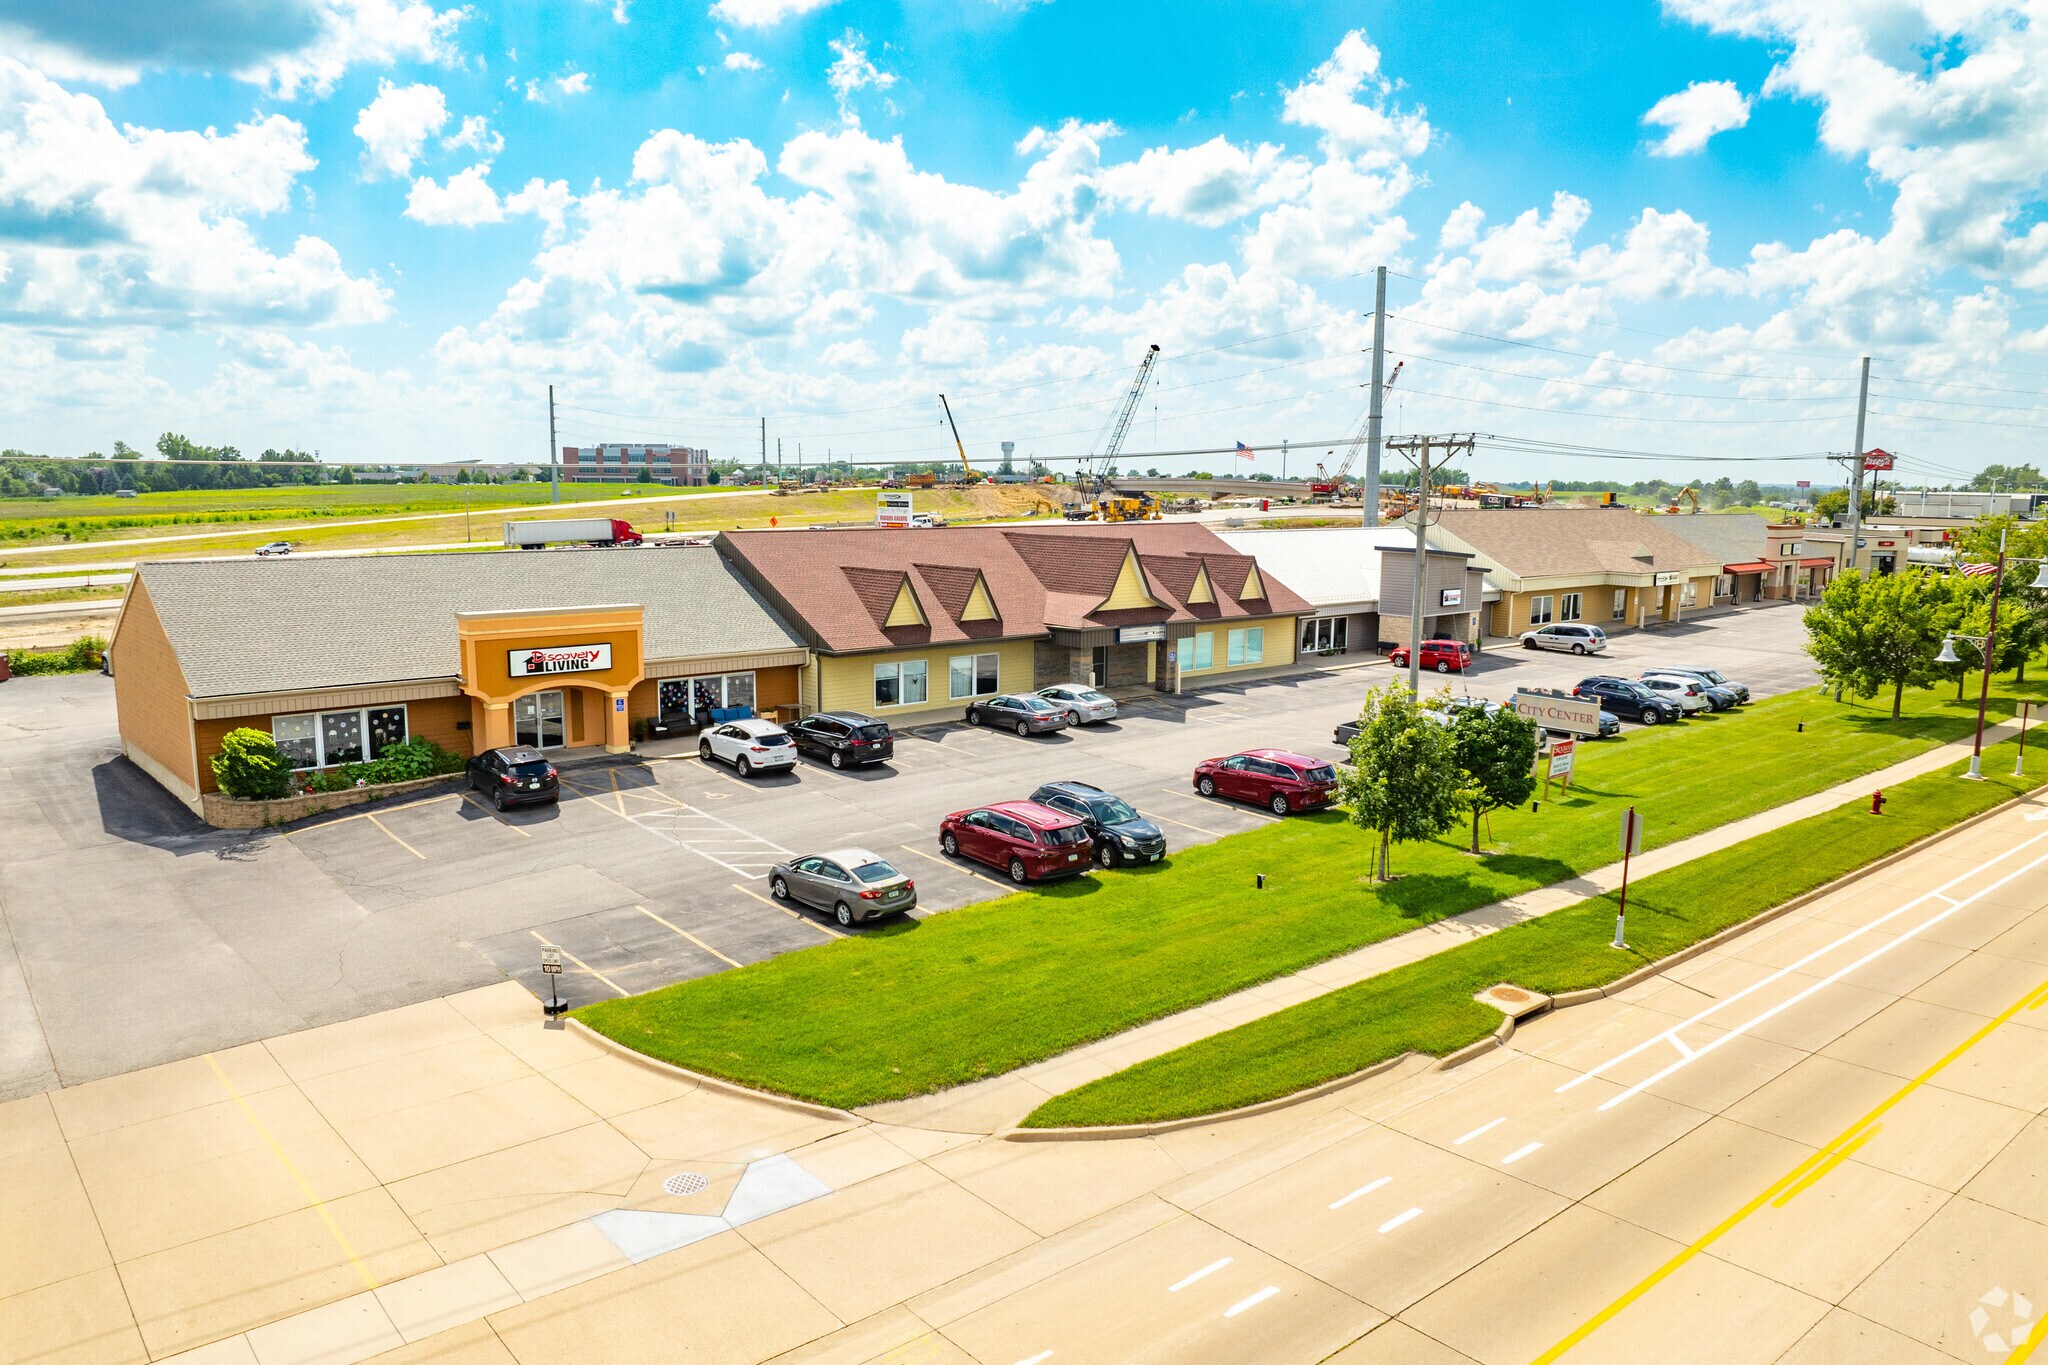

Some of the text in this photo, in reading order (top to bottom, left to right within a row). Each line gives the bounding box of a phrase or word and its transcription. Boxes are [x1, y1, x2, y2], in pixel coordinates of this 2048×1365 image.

[531, 650, 600, 663] Discovery
[545, 659, 589, 672] LIVING
[1518, 703, 1594, 724] CITY CENTER
